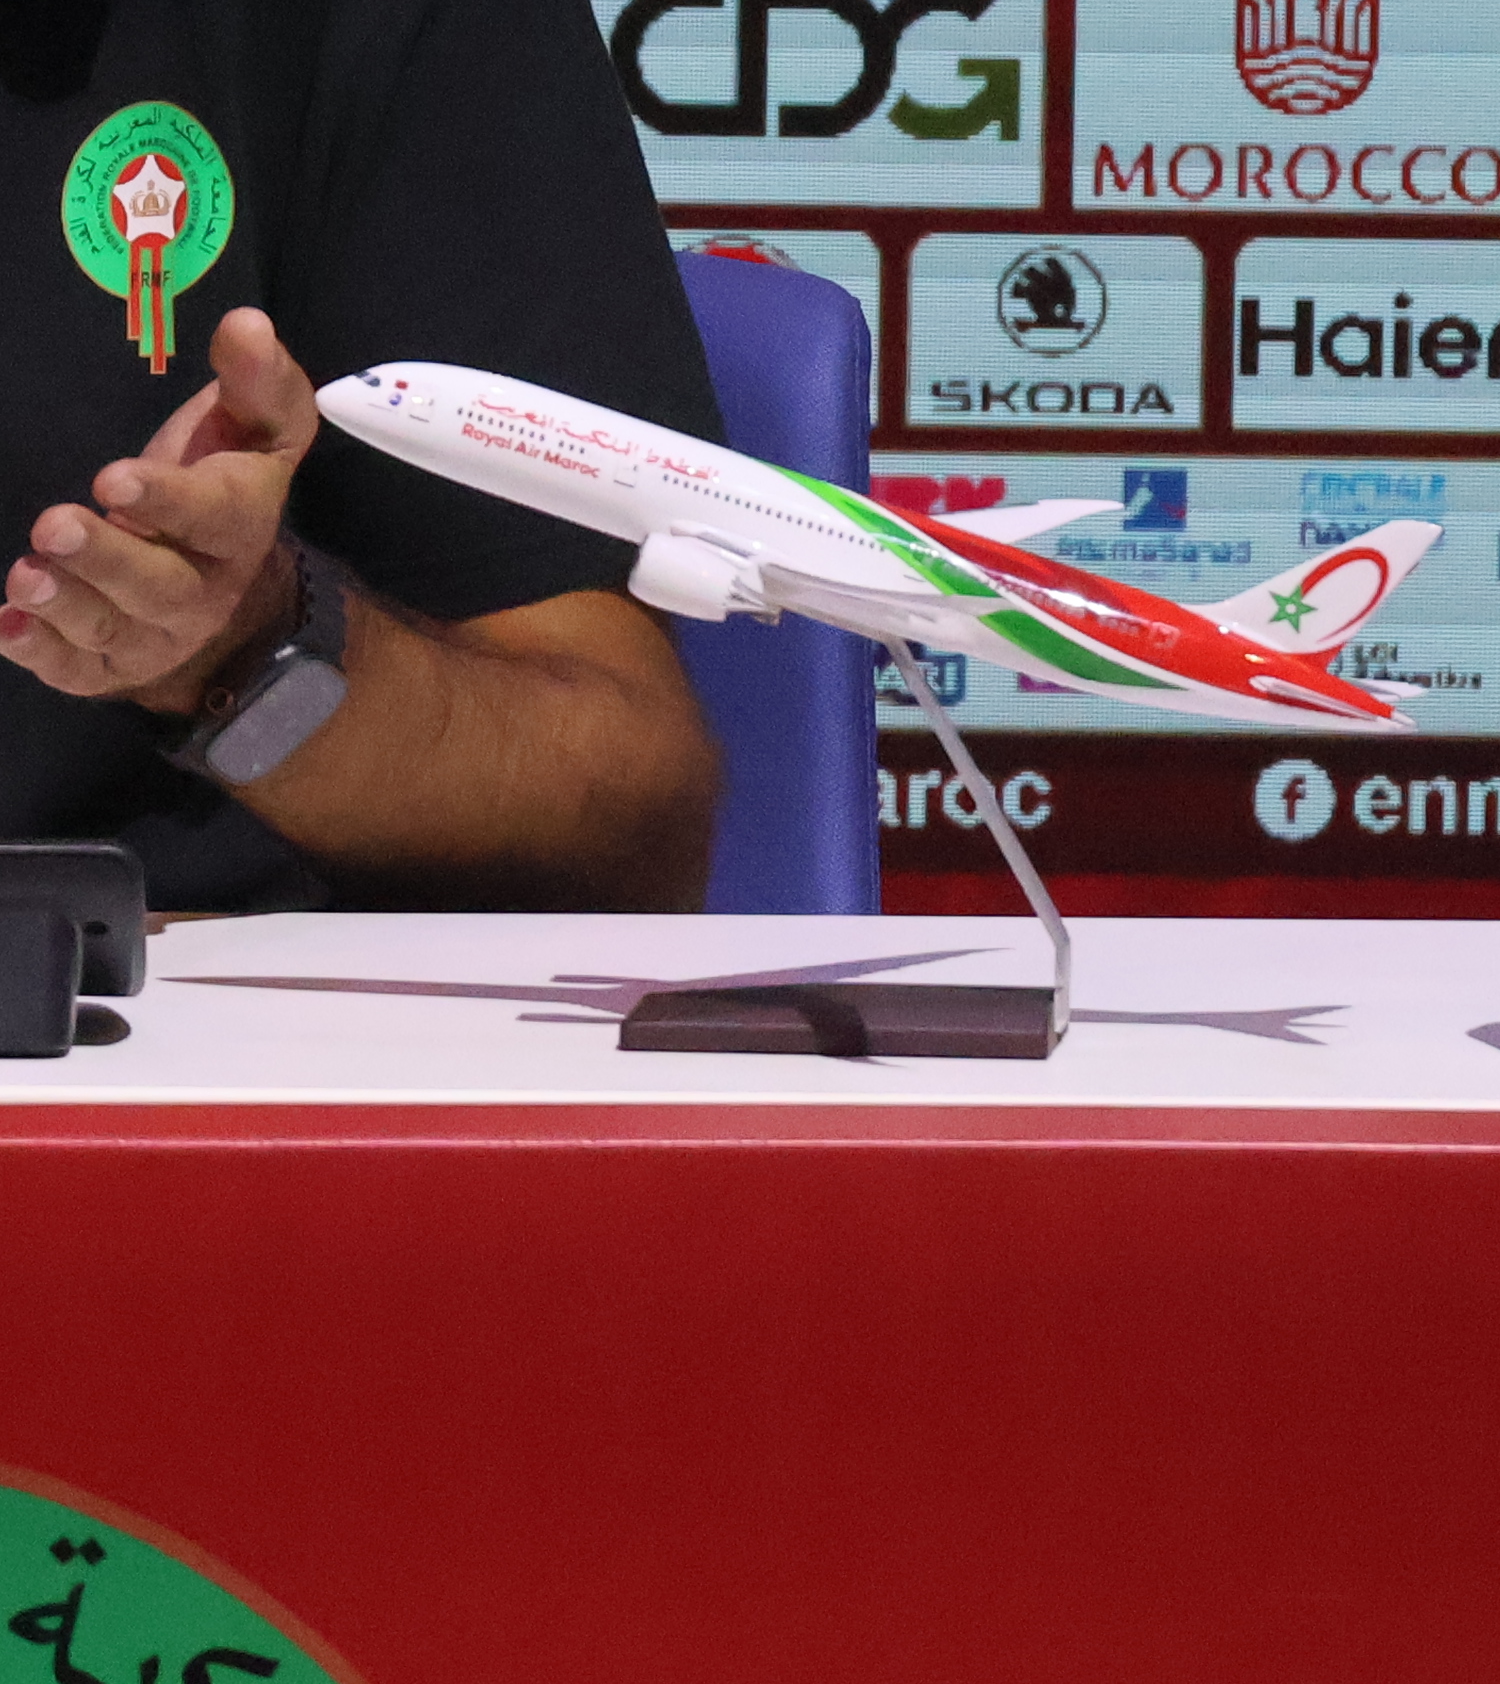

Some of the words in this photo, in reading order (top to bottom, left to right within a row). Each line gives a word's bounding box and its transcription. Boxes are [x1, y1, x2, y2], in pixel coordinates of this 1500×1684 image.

[461, 422, 512, 451] Royal
[514, 440, 540, 459] Air
[543, 450, 600, 479] Maroc
